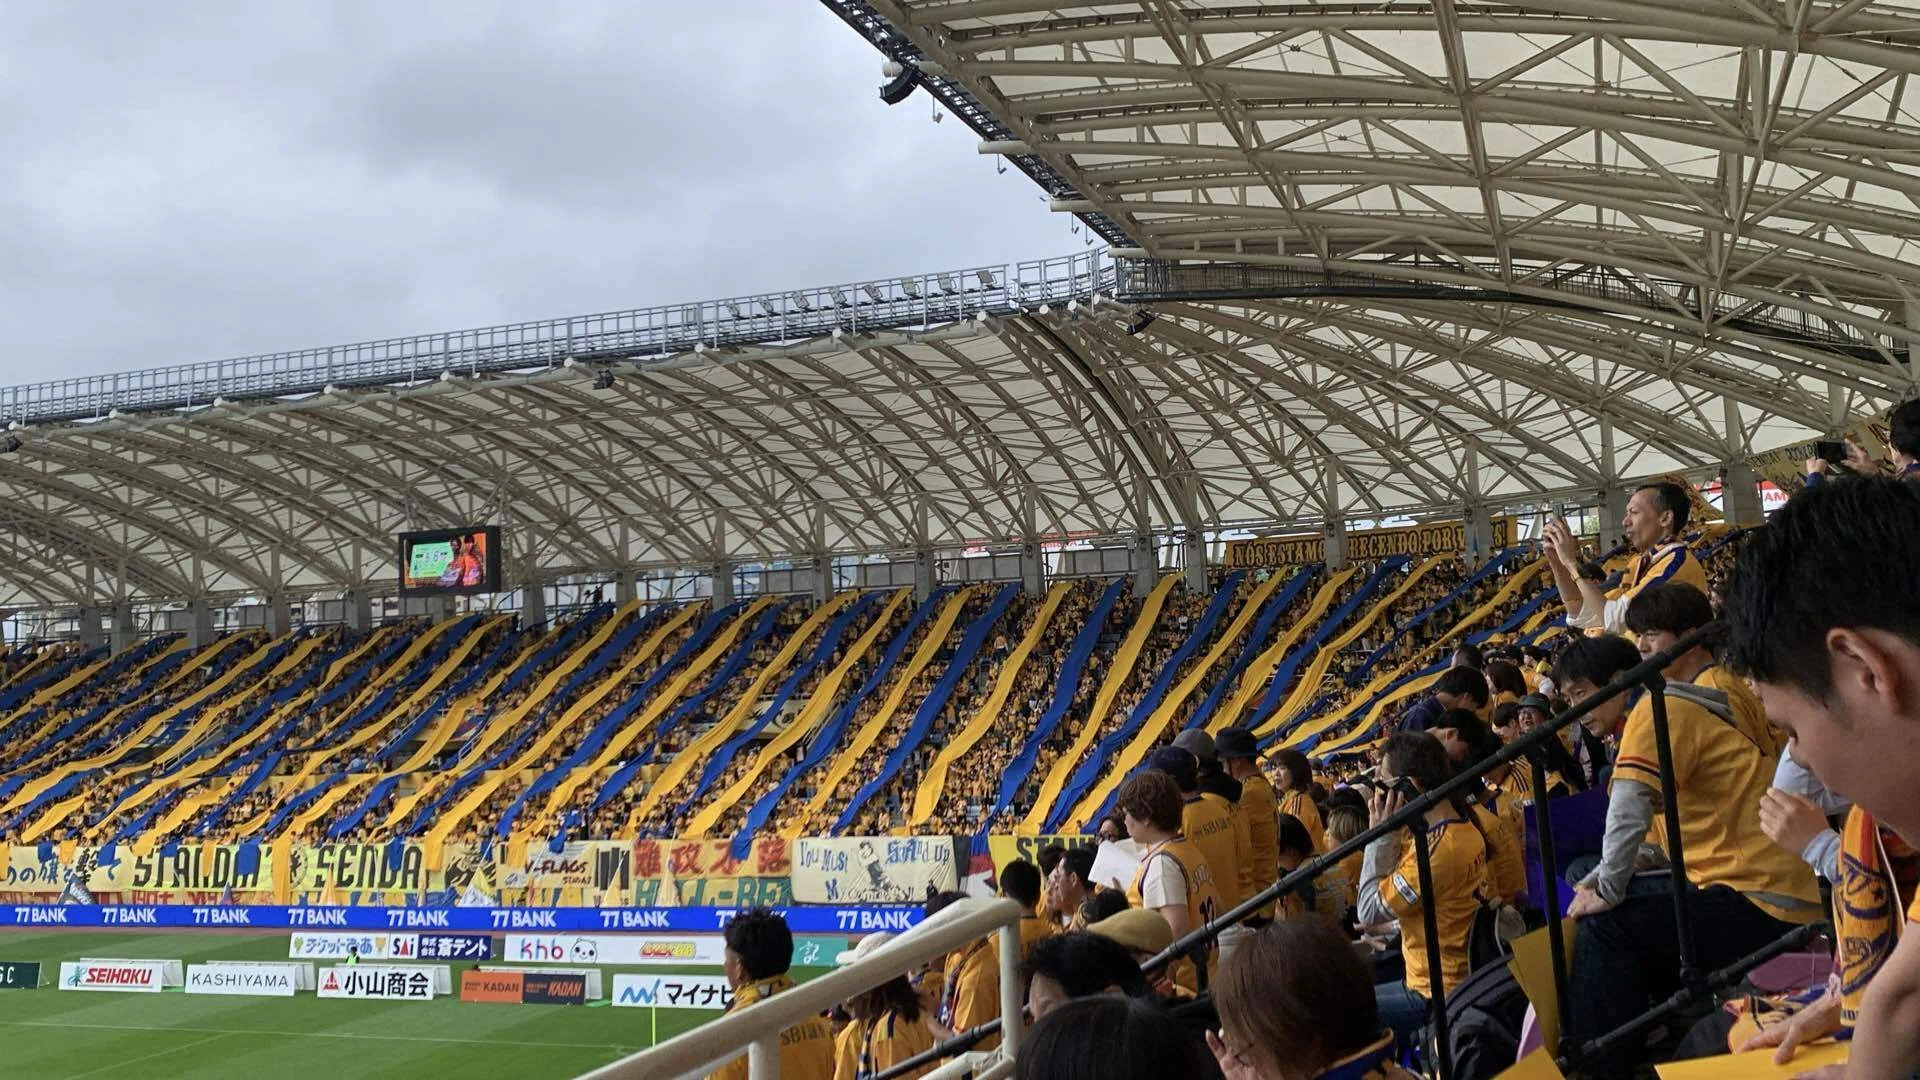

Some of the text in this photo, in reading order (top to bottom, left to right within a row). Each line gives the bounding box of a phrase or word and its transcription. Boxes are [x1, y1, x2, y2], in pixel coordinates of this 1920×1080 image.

[1267, 538, 1327, 565] ESTAMO
[1421, 526, 1453, 554] POR
[15, 908, 67, 922] 77 BANK
[102, 908, 157, 922] 77 BANK
[193, 908, 250, 923] 77 BANK
[288, 909, 347, 924] 77 BANK
[387, 910, 449, 926] 77 BANK
[491, 911, 557, 927] 77 BANK
[600, 911, 670, 927] 77 BANK
[837, 911, 912, 929] 77 BANK
[520, 937, 564, 960] khb
[85, 967, 153, 985] SEIHOKU
[192, 972, 289, 988] KASHIYAMA
[344, 971, 429, 997] 小山商会
[483, 982, 520, 993] KADAN
